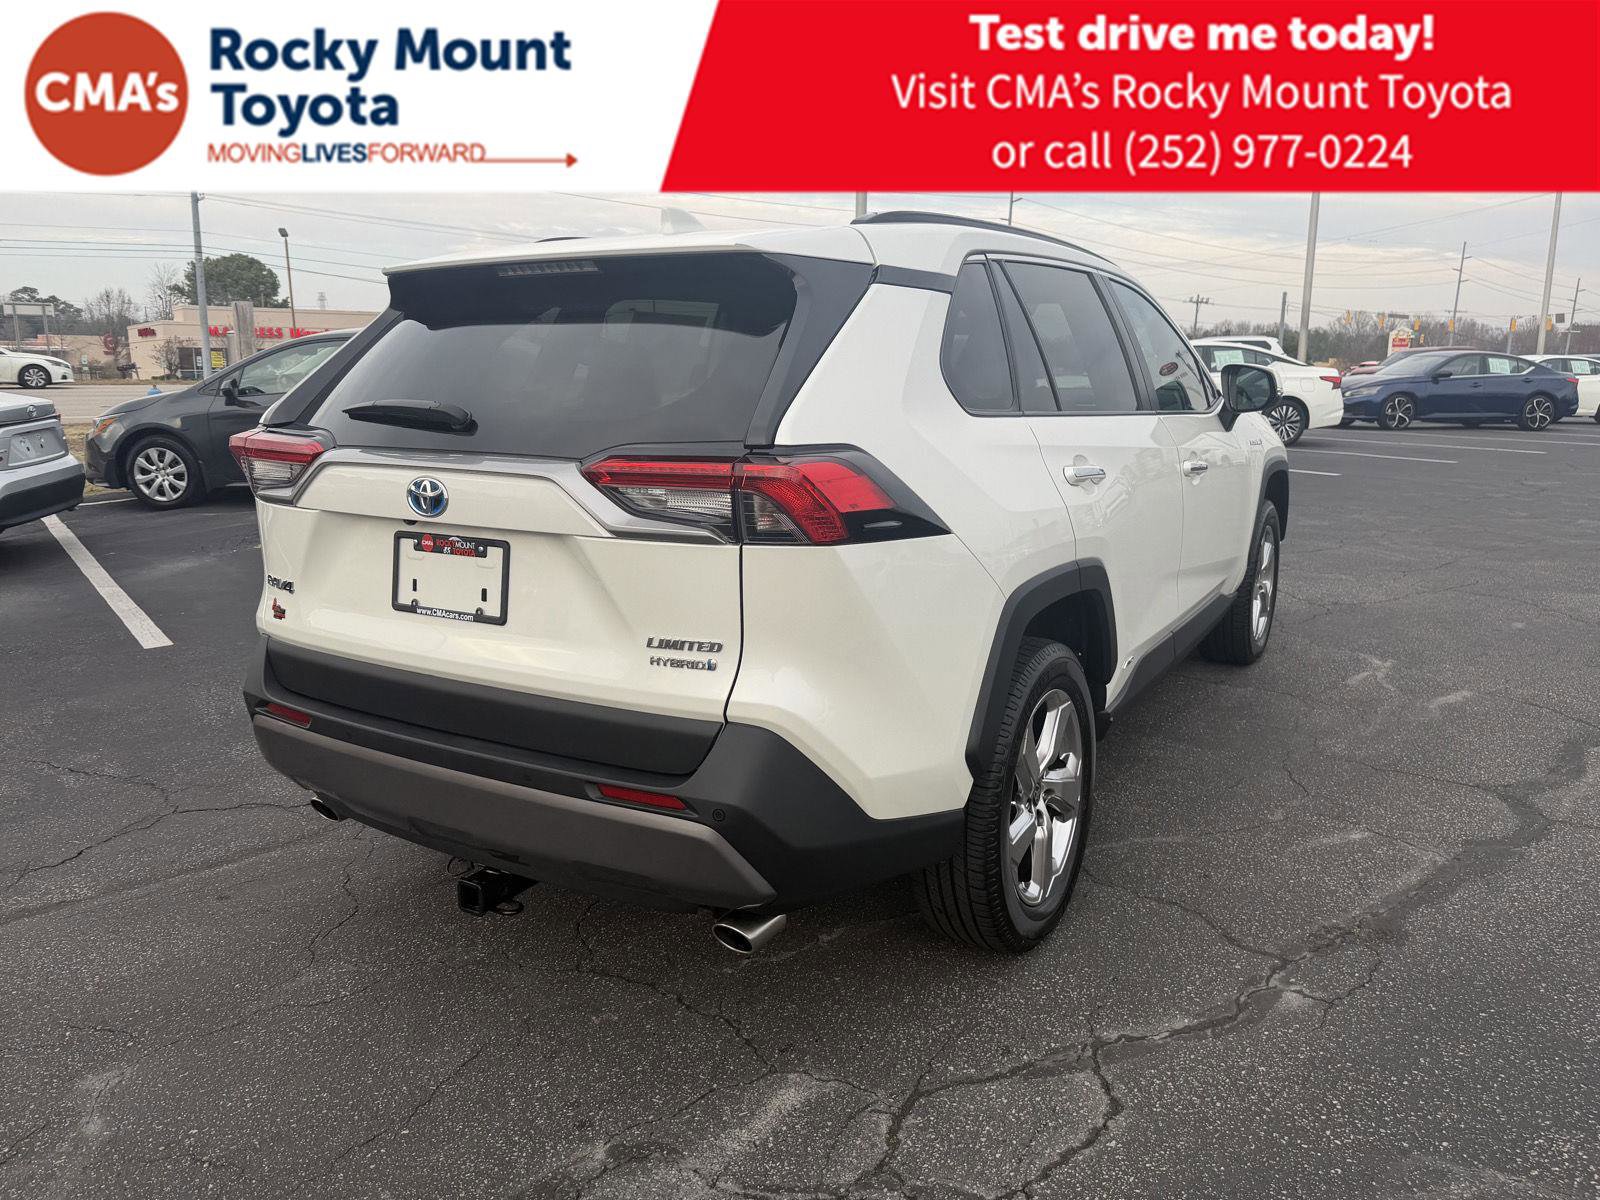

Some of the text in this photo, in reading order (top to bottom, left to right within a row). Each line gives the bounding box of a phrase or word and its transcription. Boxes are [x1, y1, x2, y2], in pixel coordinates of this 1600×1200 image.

[453, 547, 476, 557] TOYOTA
[416, 607, 474, 622] www.CMAcars.com
[646, 637, 723, 653] LIMITED
[649, 656, 707, 670] HYBRID
